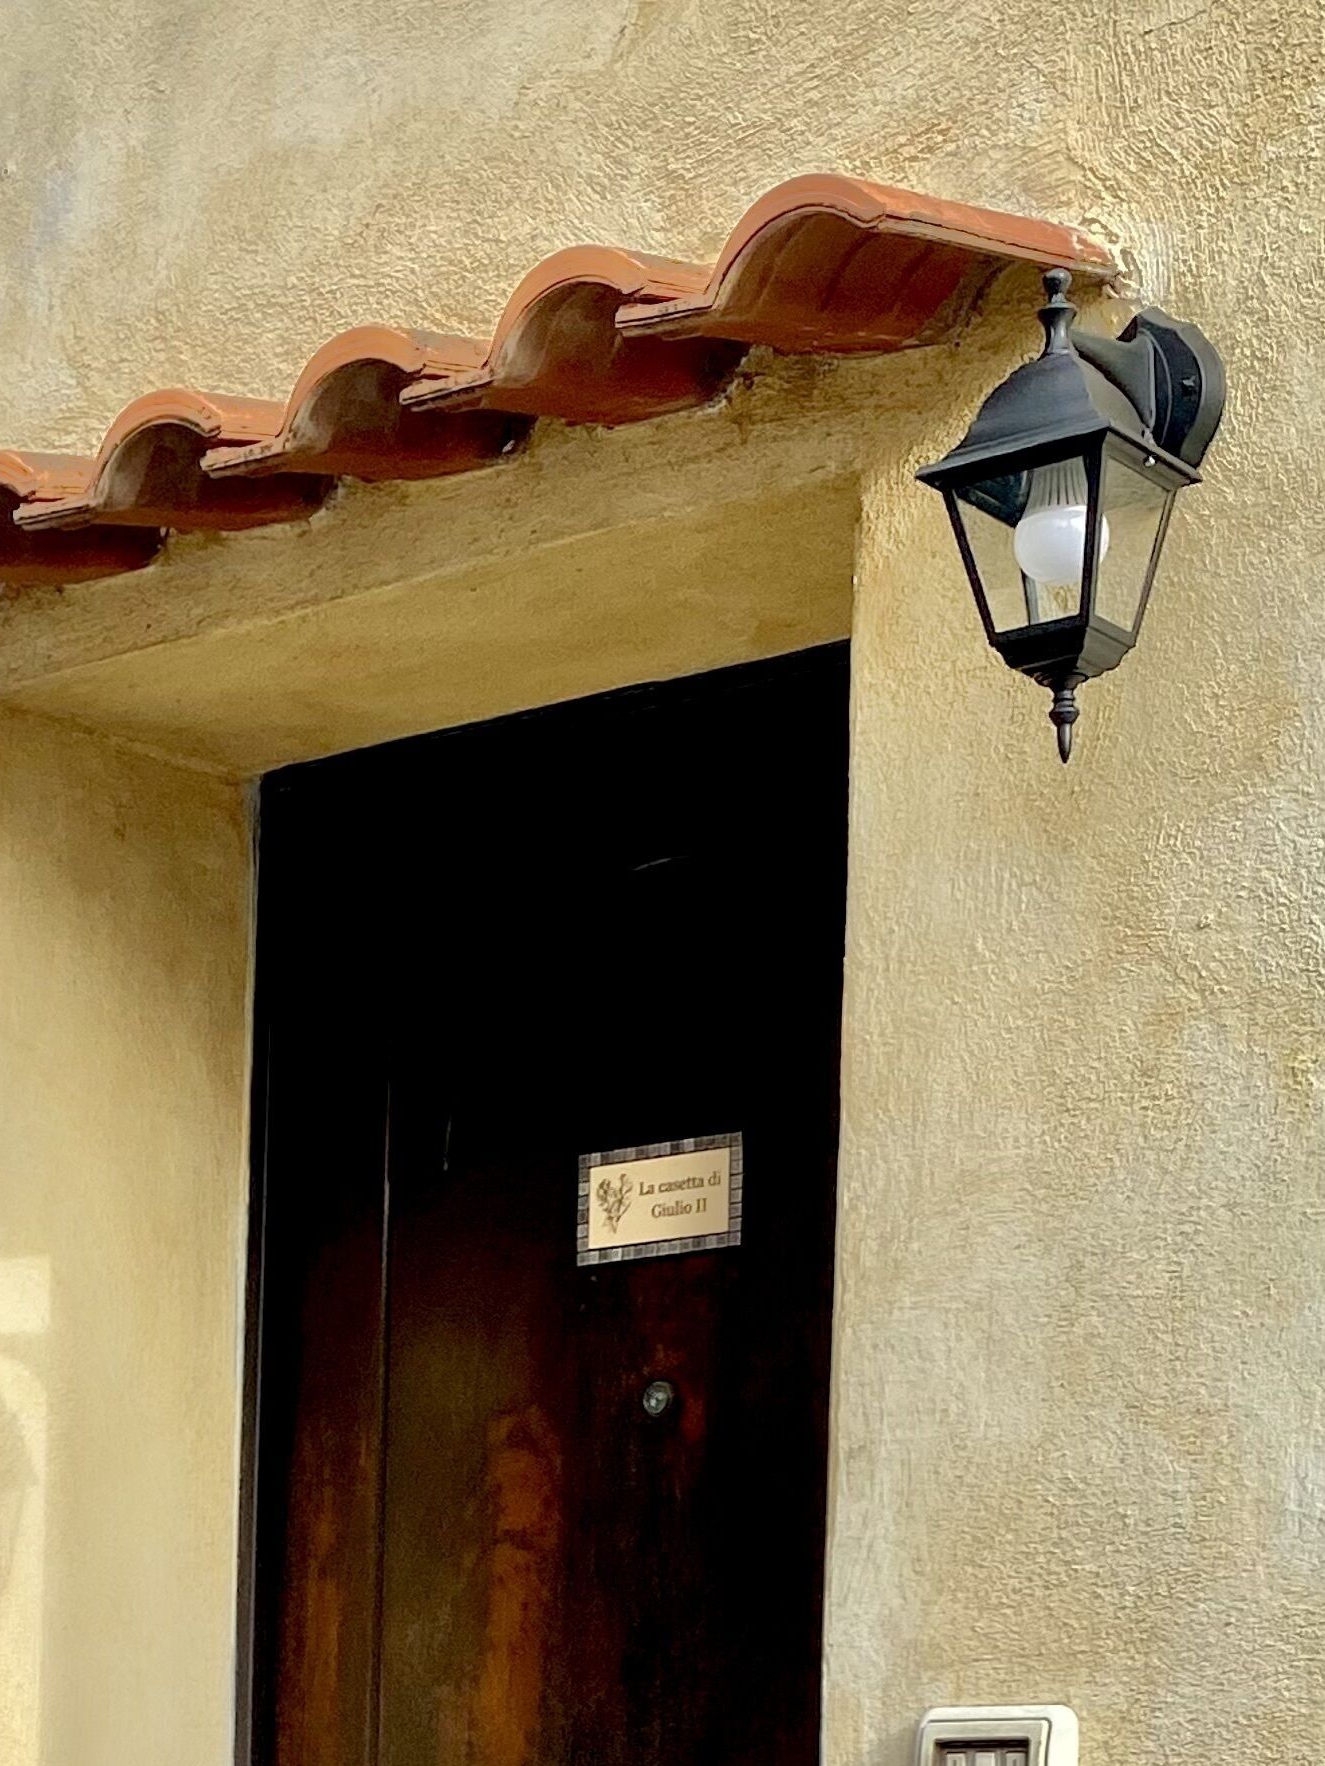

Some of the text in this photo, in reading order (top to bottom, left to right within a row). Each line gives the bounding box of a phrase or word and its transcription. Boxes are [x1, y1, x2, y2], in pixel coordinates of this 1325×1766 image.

[638, 1170, 721, 1196] La casetta di
[651, 1200, 692, 1218] Giulio
